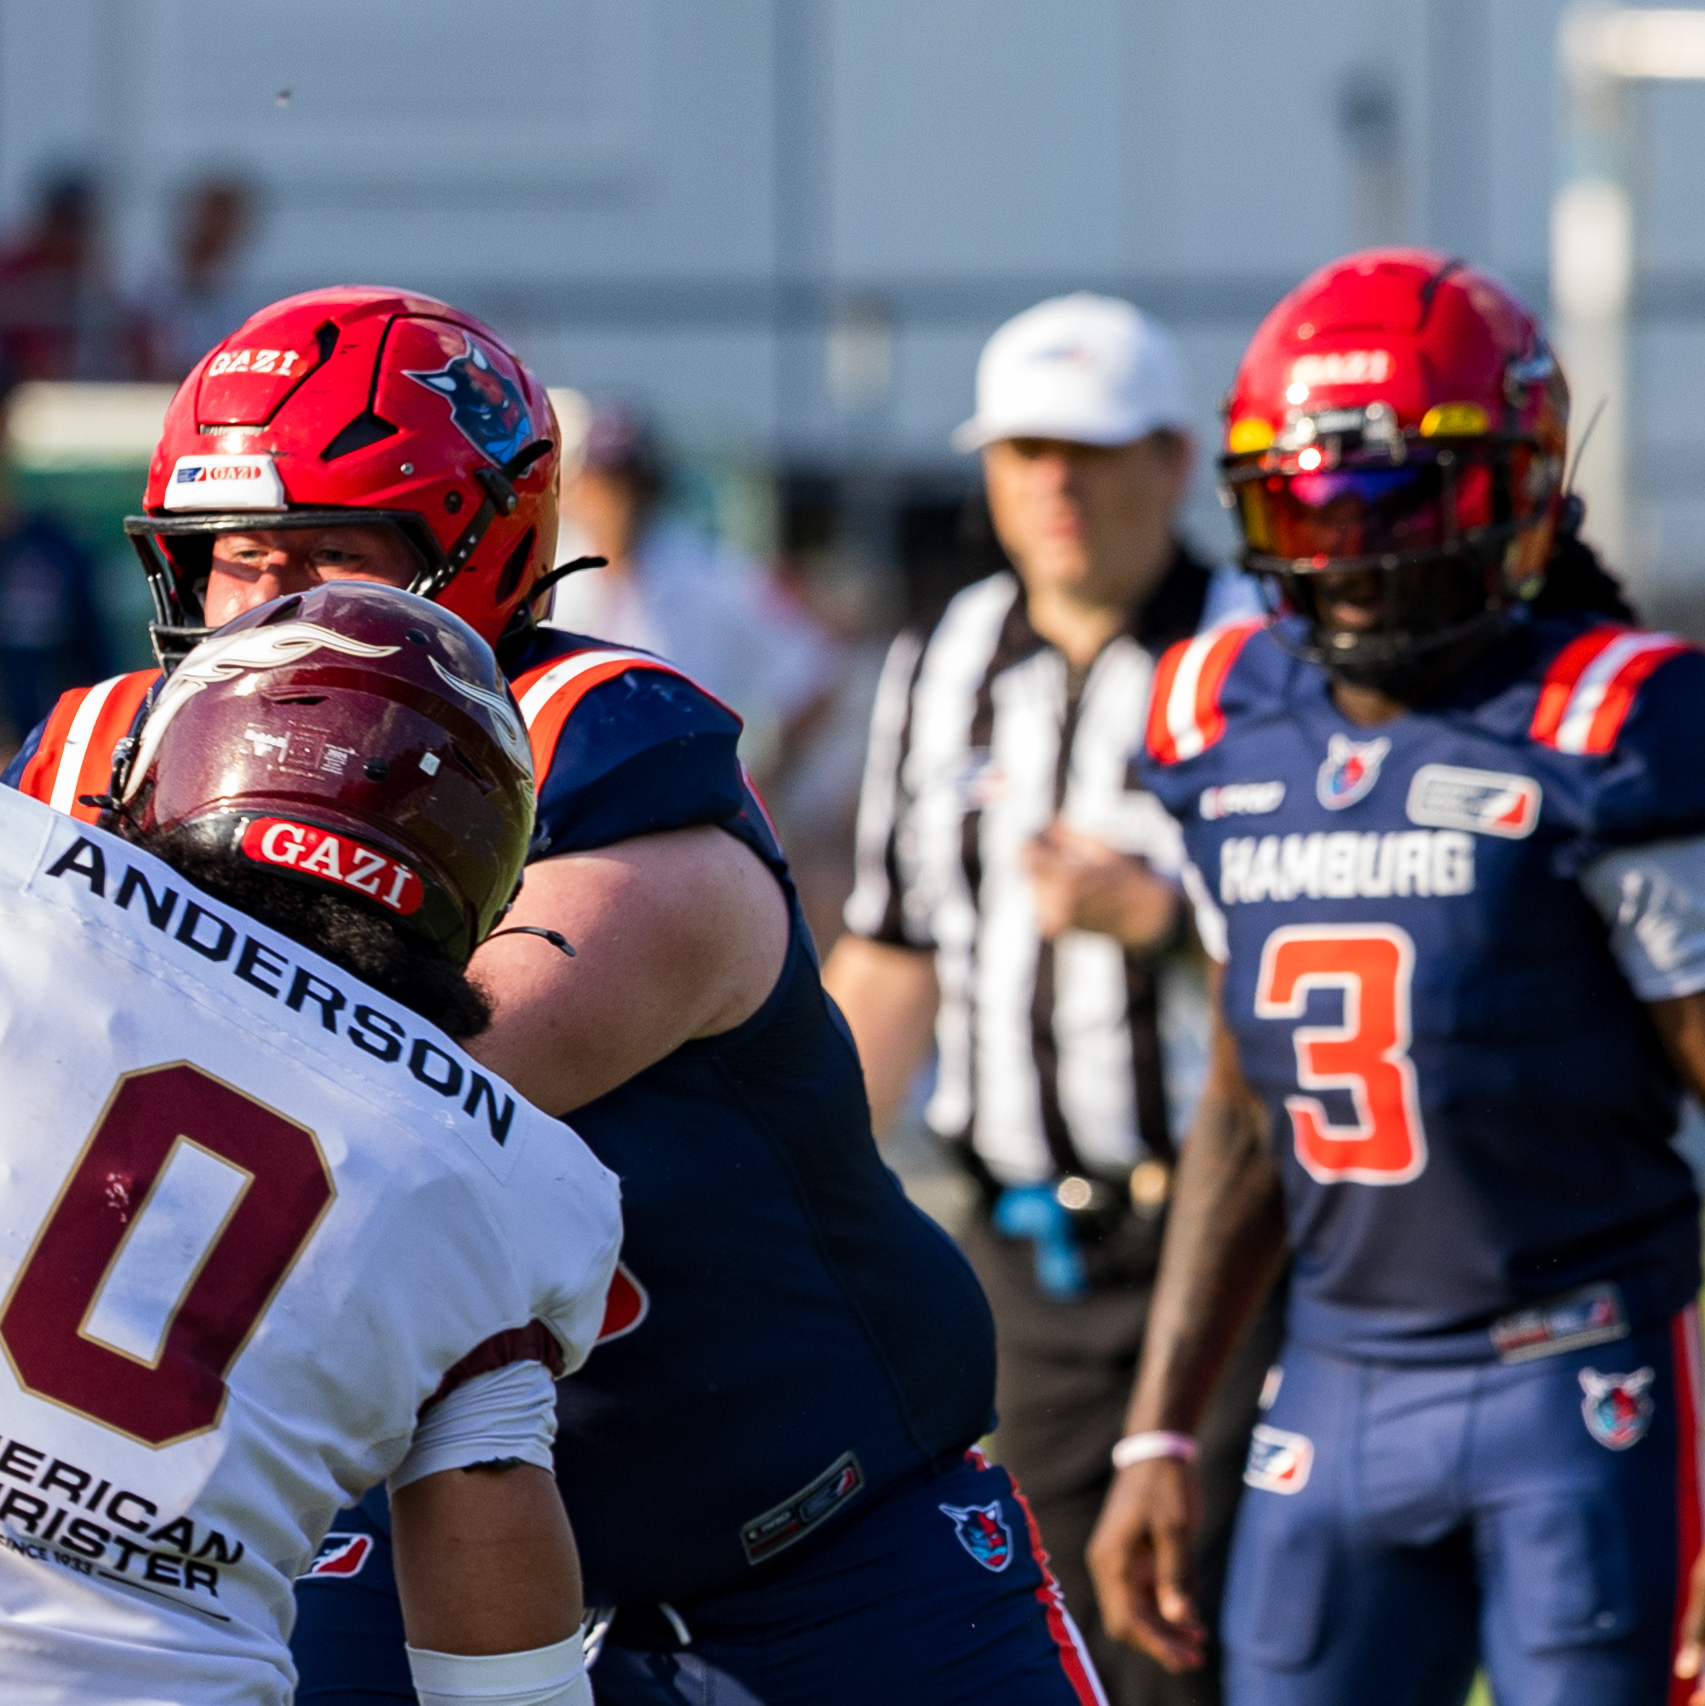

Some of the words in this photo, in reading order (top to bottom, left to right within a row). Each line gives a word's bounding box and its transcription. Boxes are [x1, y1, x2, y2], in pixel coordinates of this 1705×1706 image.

[1219, 828, 1477, 905] HAMBURG
[45, 834, 517, 1149] ANDERSON
[1253, 922, 1429, 1185] 3
[54, 1550, 93, 1577] 1933
